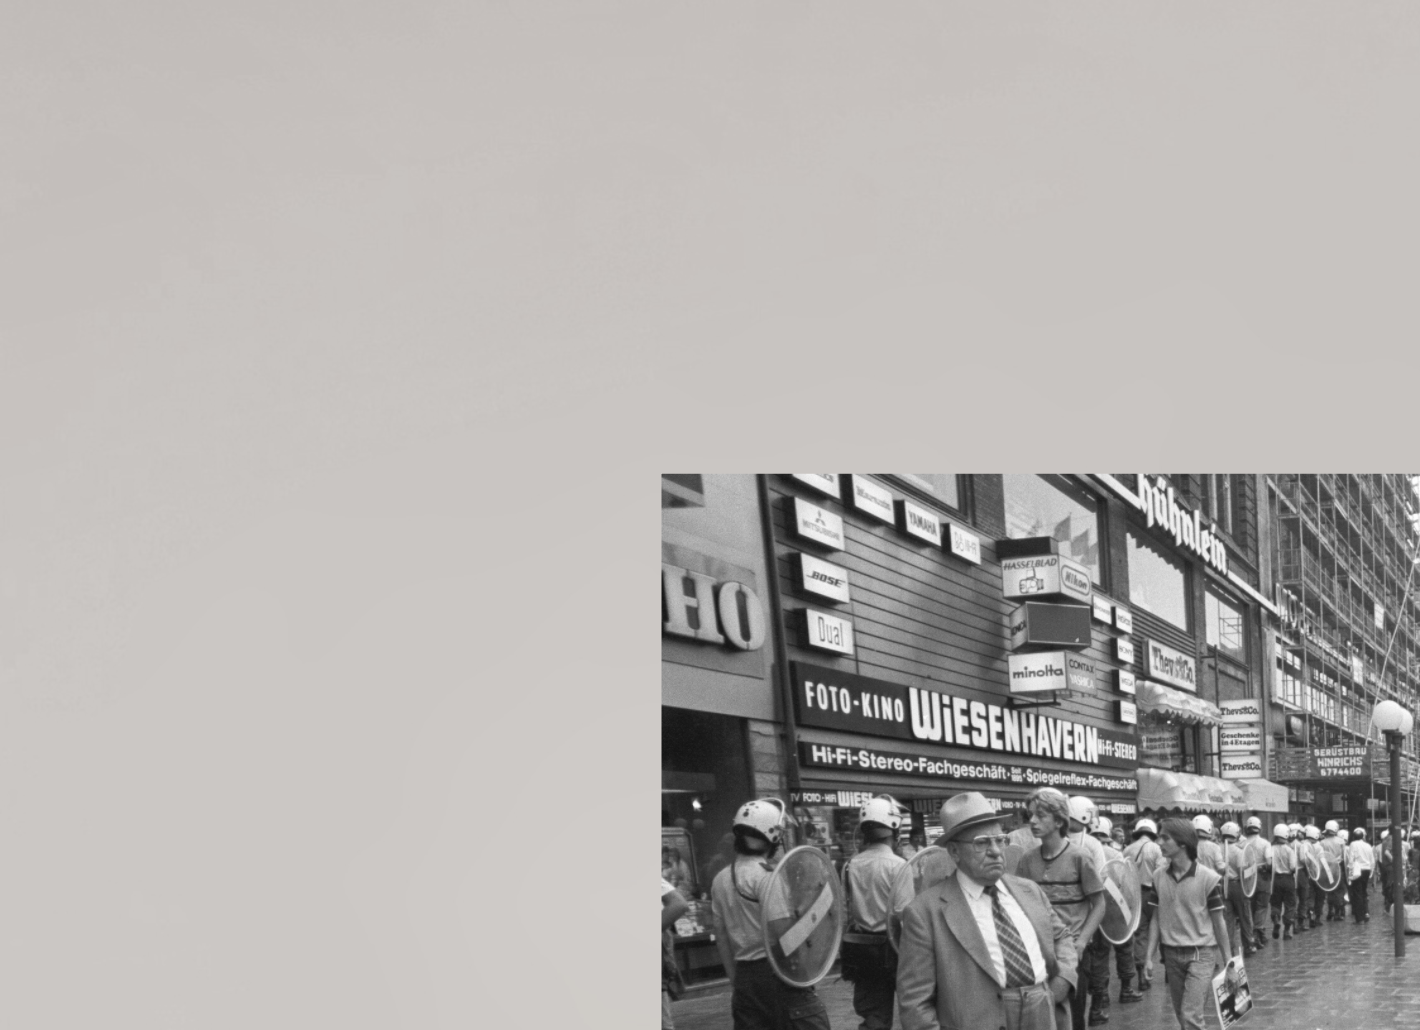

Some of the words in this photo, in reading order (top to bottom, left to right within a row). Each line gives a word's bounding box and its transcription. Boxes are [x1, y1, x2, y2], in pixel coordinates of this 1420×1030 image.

[908, 510, 938, 537] YAMAHA
[1003, 558, 1057, 571] HASSELBLAD
[806, 570, 846, 588] BOSE
[1065, 571, 1088, 591] Nikon
[818, 616, 844, 647] Dual
[1012, 664, 1064, 679] minolta
[1068, 658, 1094, 674] CONTAX
[1234, 739, 1260, 747] Etagen
[1317, 756, 1363, 767] HINRICHS
